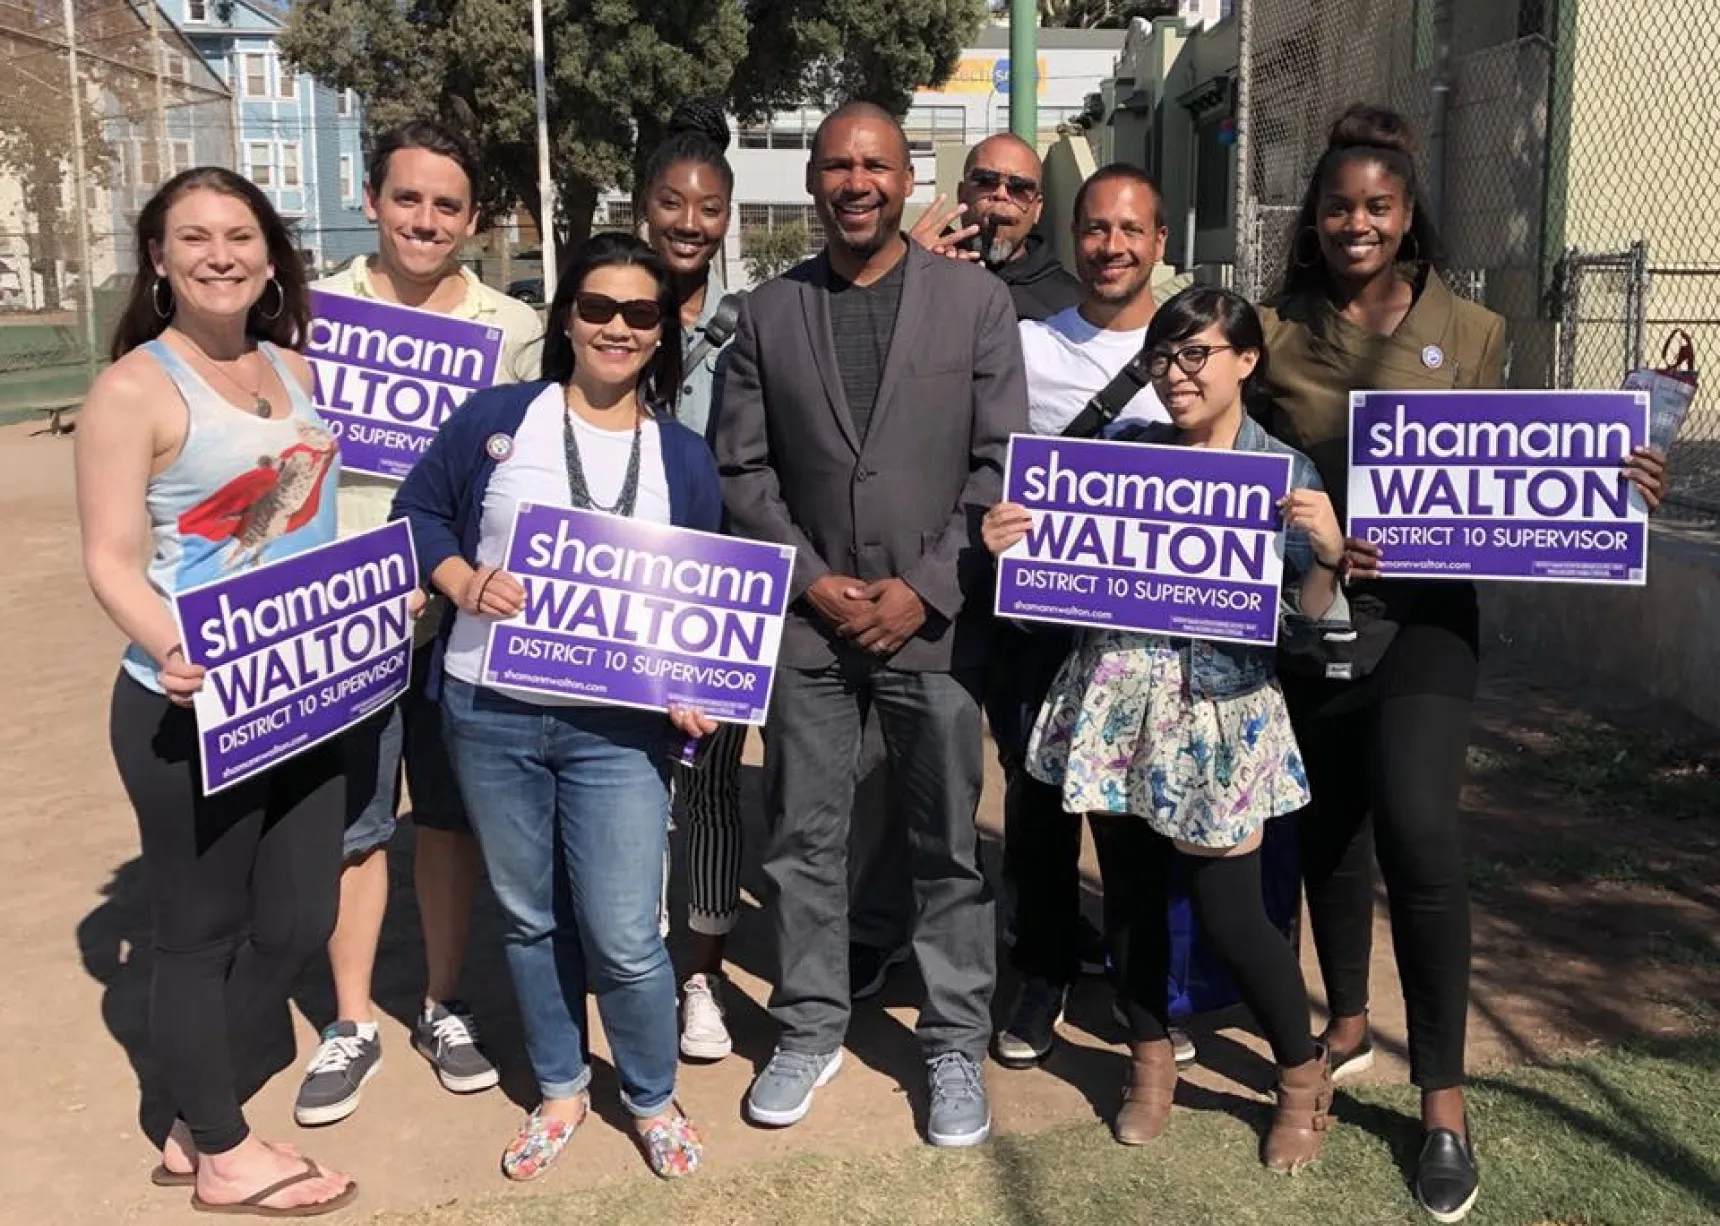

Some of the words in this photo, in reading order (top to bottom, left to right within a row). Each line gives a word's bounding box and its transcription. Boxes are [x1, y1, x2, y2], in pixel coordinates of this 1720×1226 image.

[306, 318, 483, 381] amann
[348, 424, 433, 453] SUPERVI
[1369, 405, 1630, 458] shamann
[1023, 450, 1270, 520] shamann
[1369, 469, 1628, 518] WALTON
[526, 519, 773, 606] shamann
[1025, 513, 1266, 580] WALTON
[1367, 527, 1455, 546] DISTRICT
[1463, 527, 1486, 547] 10
[1492, 529, 1628, 550] SUPERVISOR
[200, 553, 406, 658] shamann
[524, 577, 765, 661] WALTON
[1016, 569, 1098, 594] DISTRICT
[1107, 578, 1128, 598] 10
[1134, 581, 1262, 612] SUPERVISOR
[211, 597, 406, 718] WALTON
[503, 668, 608, 693] shamannwalton.com
[509, 635, 597, 666] DISTRICT
[604, 650, 627, 671] 10
[632, 654, 757, 691] SUPERVISOR
[219, 704, 292, 754] DISTRICT
[299, 695, 317, 718] 10
[320, 651, 405, 707] SUPERVISOR
